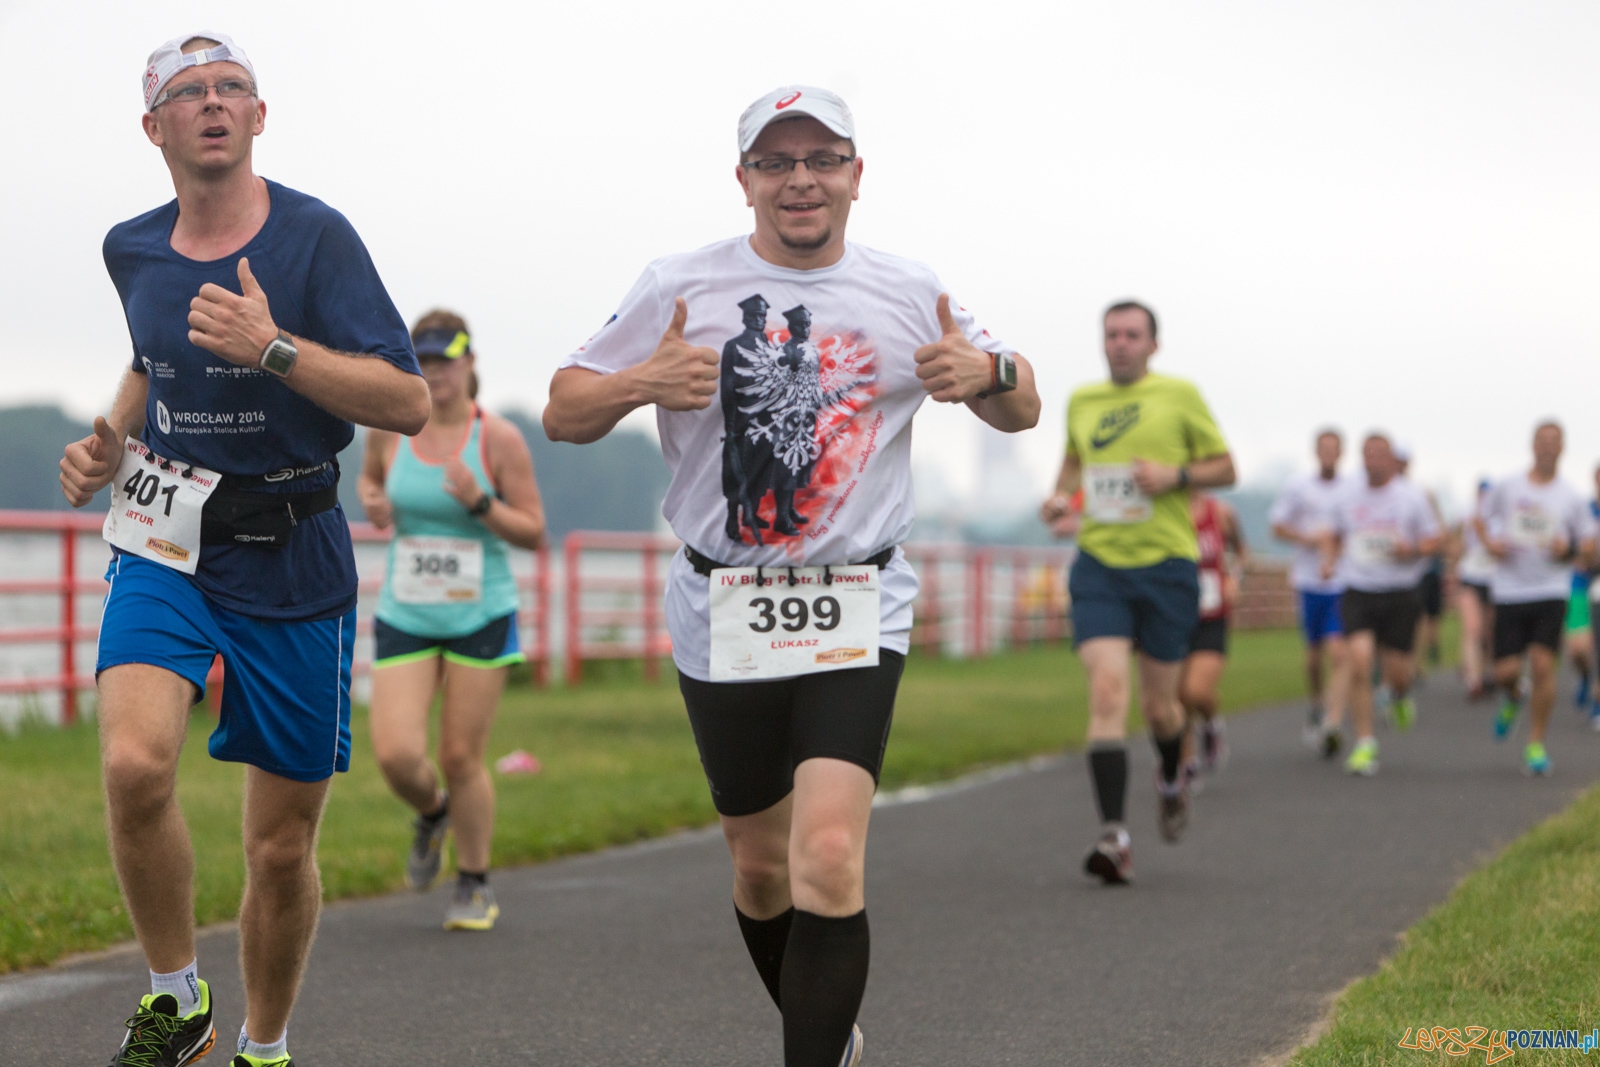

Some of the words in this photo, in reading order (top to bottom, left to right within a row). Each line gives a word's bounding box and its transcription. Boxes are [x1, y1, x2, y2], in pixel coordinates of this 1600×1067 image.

[206, 366, 262, 374] BRUBEC
[173, 411, 234, 424] WROCŁAW
[238, 411, 265, 423] 2016
[175, 425, 212, 435] Europejska
[213, 426, 237, 434] Stolica
[239, 425, 265, 434] Kultury
[127, 442, 137, 453] IV
[123, 468, 180, 517] 401
[125, 509, 154, 526] ARTUR
[148, 540, 164, 552] Piotr
[721, 575, 735, 586] IV
[741, 574, 773, 587] Big
[778, 574, 812, 585] Potr
[748, 595, 841, 633] 399
[770, 639, 819, 649] ŁUKASZ
